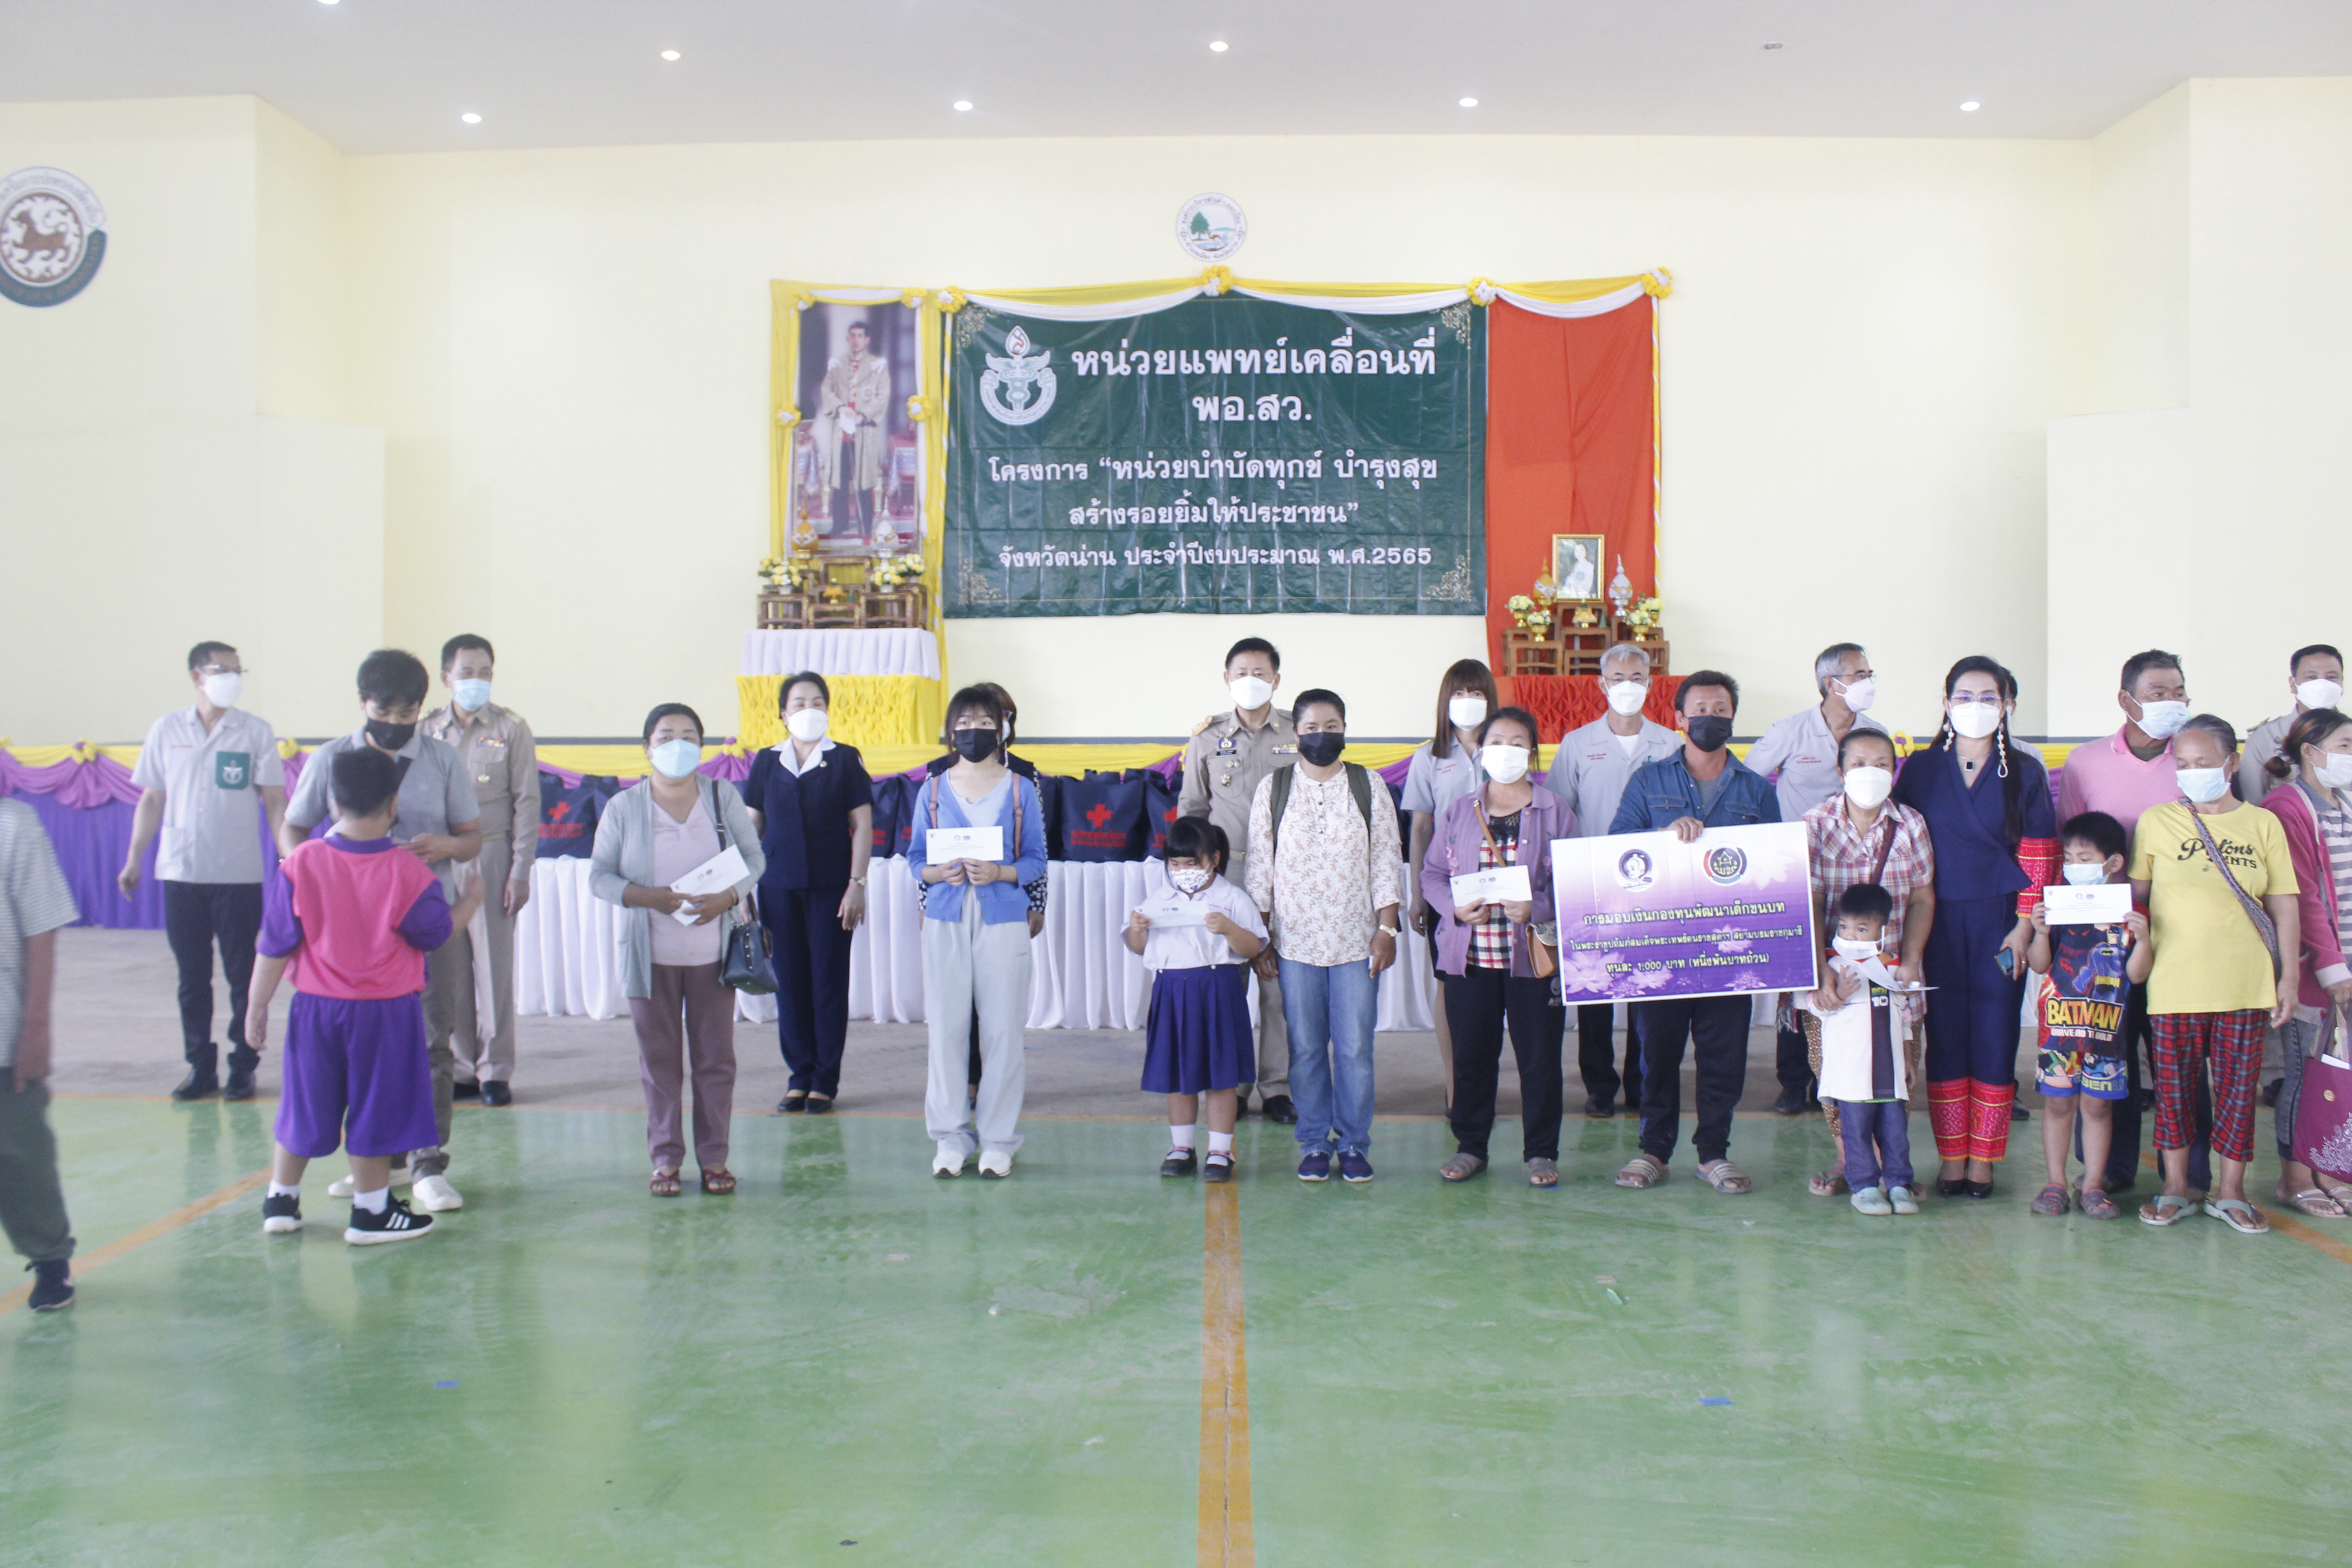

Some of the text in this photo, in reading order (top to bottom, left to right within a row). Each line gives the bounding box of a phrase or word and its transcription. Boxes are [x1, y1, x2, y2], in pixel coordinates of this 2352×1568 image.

[1072, 326, 1436, 376] หน่วยแพทย์เคลื่อนที่
[1192, 394, 1313, 421] พอ.สว.
[988, 449, 1437, 490] โครงการ “หน่วยบำบัดทุกข์ บำรุงสุข
[1068, 489, 1359, 526] สร้างรอยยิ้มให้ประชาชน”
[999, 541, 1432, 568] จังหวัดน่าน ประจำปีงบประมาณ พ.ศ.2565
[1606, 961, 1632, 978] ทุนละ
[1666, 959, 1686, 970] บาท
[1872, 995, 1888, 1007] 10
[2047, 1000, 2121, 1030] BATMAN
